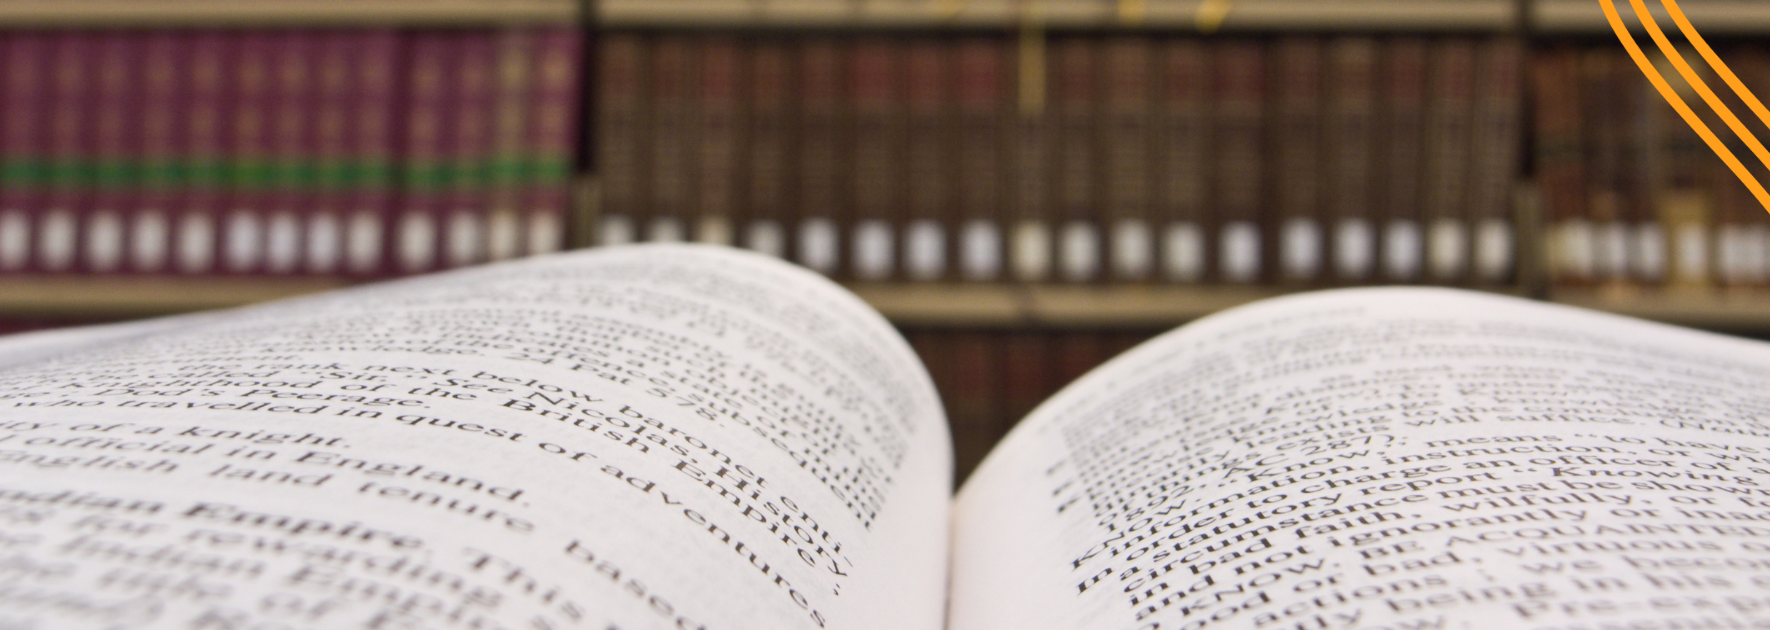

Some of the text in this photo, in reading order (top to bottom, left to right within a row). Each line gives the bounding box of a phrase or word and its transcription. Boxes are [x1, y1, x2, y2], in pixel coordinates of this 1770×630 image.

[69, 423, 136, 432] of
[177, 425, 352, 448] knight.
[240, 389, 430, 408] Peerage.
[472, 371, 603, 402] below
[619, 405, 766, 488] baronet
[1426, 436, 1562, 448] means
[1654, 437, 1760, 453] have
[24, 437, 216, 455] official
[225, 446, 277, 460] in
[294, 451, 528, 505] England.
[117, 401, 329, 414] travelled
[336, 407, 382, 418] in
[396, 415, 522, 441] quest
[538, 443, 597, 461] of
[601, 465, 825, 628] adventures
[208, 464, 333, 487] land
[358, 482, 534, 531] tenure
[340, 380, 396, 391] of
[408, 388, 477, 400] the
[501, 399, 654, 453] British
[673, 460, 815, 567] Empire
[432, 379, 513, 393] See
[518, 392, 698, 463] Nicolas,
[715, 466, 847, 576] History
[1077, 568, 1113, 594] In
[1126, 509, 1233, 561] order
[1247, 494, 1287, 508] to
[1301, 465, 1451, 494] charge
[1463, 460, 1518, 469] an
[1529, 456, 1676, 467] officer
[1691, 462, 1735, 471] of
[1111, 466, 1369, 557] information,
[1382, 444, 1637, 465] instruction,
[1120, 566, 1141, 581] a
[1153, 493, 1341, 562] statutory
[1359, 472, 1501, 495] report
[1124, 495, 1428, 593] circumstance
[1437, 482, 1556, 499] must
[1559, 480, 1623, 489] be
[1131, 583, 1169, 606] in
[1189, 538, 1272, 575] bad
[1669, 496, 1715, 505] or
[1136, 575, 1215, 621] and
[1234, 546, 1309, 575] not
[1328, 509, 1586, 547] ignorantly
[1610, 509, 1658, 517] or
[1359, 542, 1423, 560] BE
[1293, 576, 1338, 593] or
